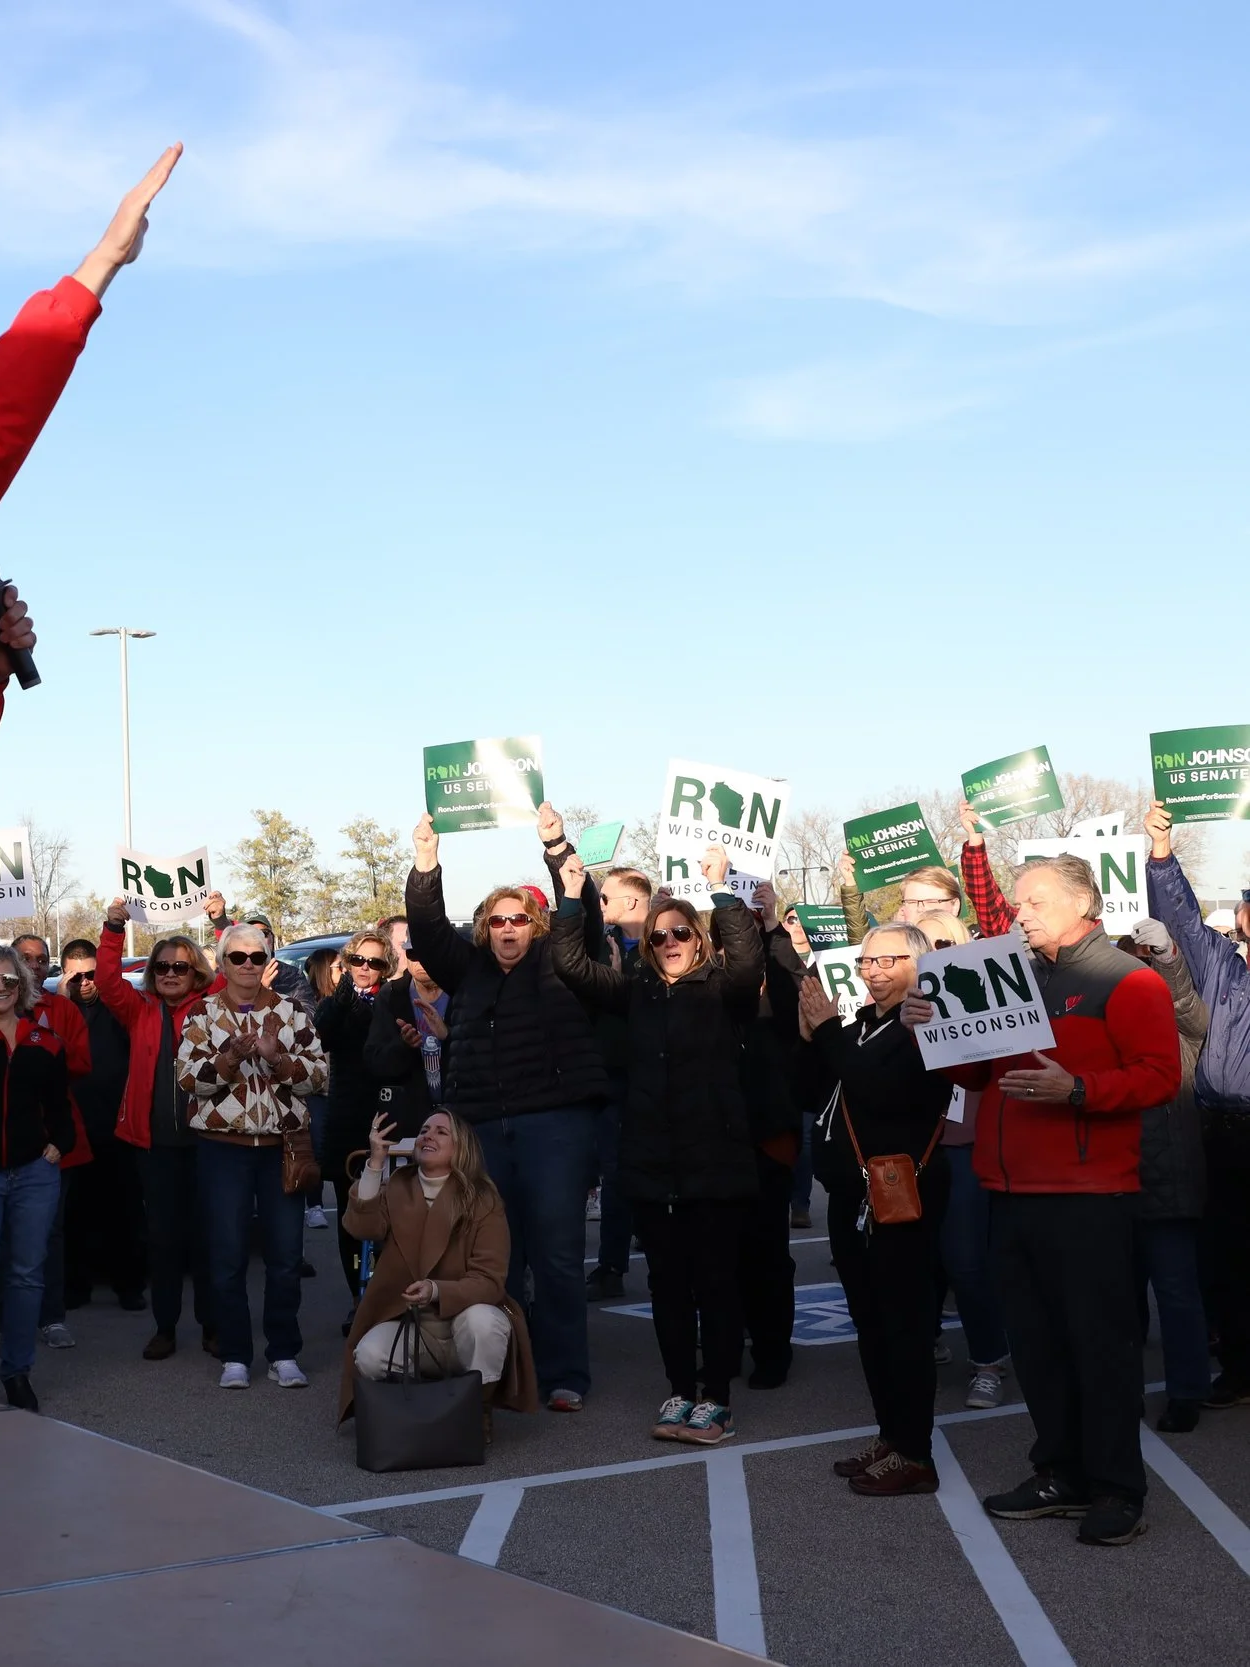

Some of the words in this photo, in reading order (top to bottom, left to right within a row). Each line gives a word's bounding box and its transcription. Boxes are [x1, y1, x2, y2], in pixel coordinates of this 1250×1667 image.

[1170, 772, 1186, 784] US
[1190, 768, 1249, 782] SENATE
[443, 783, 461, 795] US
[980, 792, 995, 802] US
[668, 823, 772, 857] WISCONSIN
[871, 818, 926, 843] JOHNSON
[860, 848, 876, 859] US
[878, 837, 918, 855] SENATE
[123, 889, 208, 911] WISCONSIN
[924, 1009, 1040, 1044] WISCONSIN
